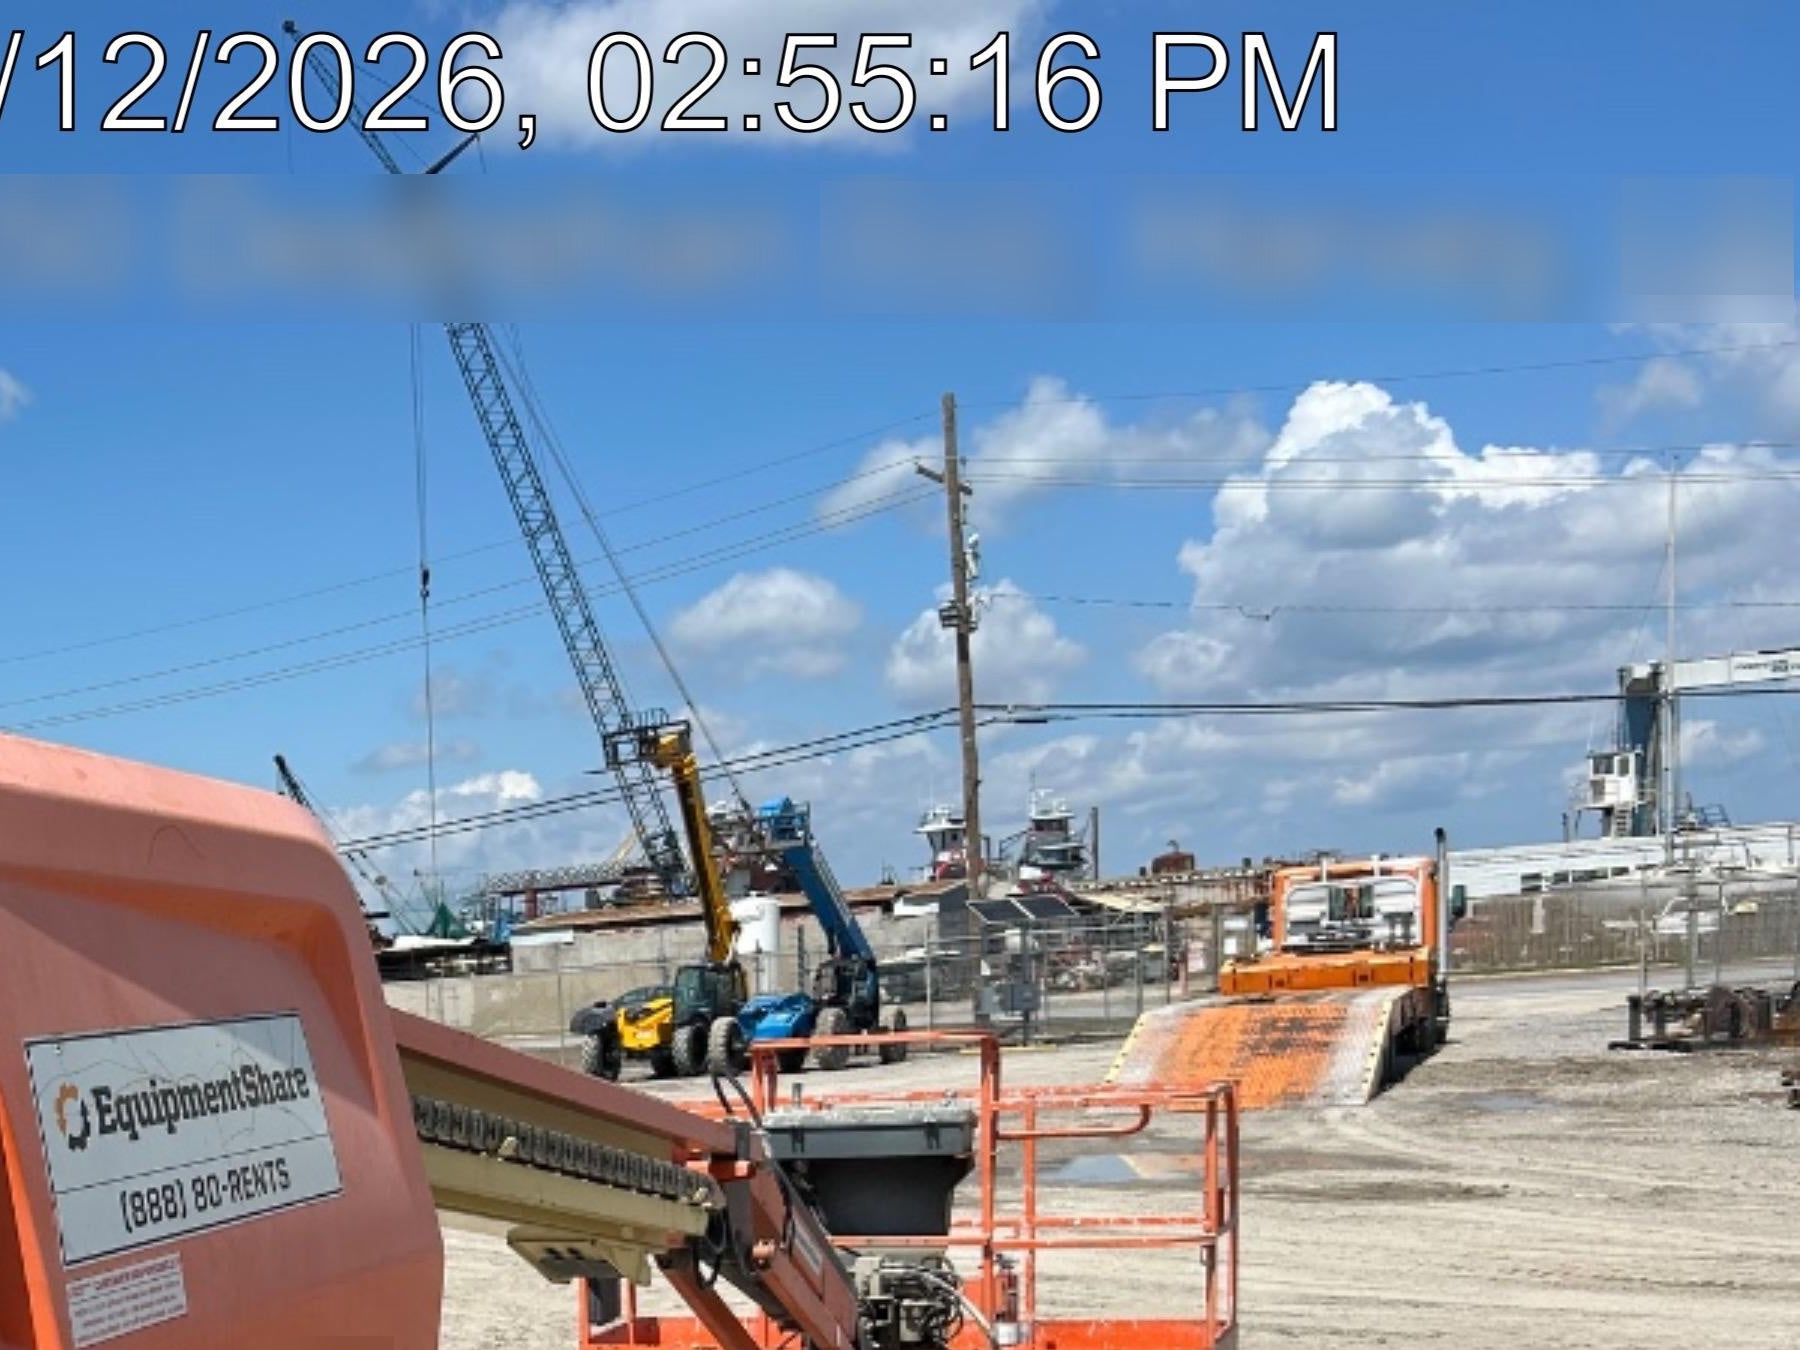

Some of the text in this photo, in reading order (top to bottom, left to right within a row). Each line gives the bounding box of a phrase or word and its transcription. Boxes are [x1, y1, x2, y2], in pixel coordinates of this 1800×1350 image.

[91, 1064, 310, 1140] EquipmentShare
[119, 1157, 291, 1233] (888) 80-RENTS
